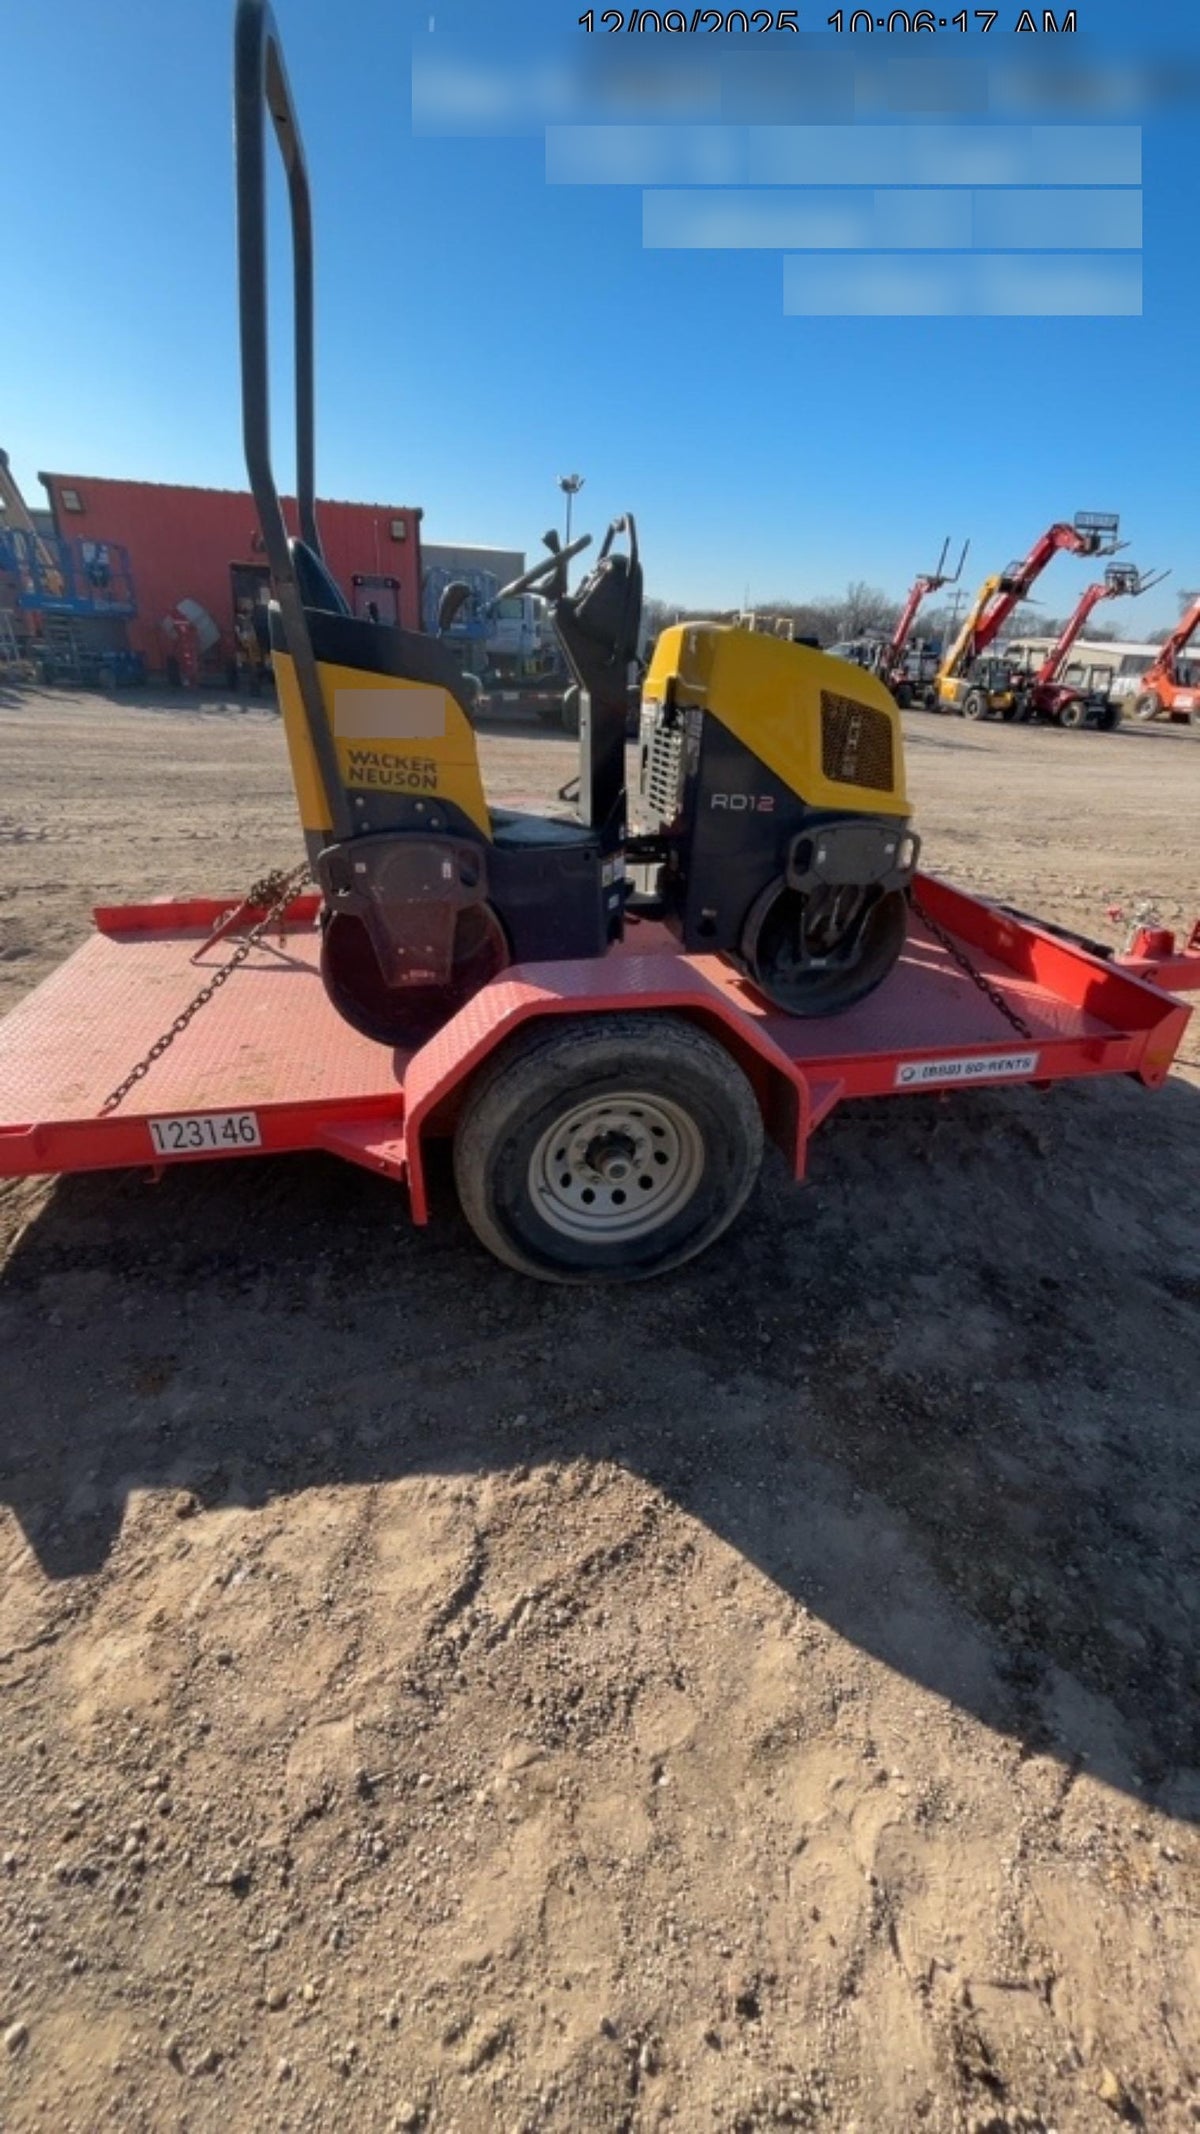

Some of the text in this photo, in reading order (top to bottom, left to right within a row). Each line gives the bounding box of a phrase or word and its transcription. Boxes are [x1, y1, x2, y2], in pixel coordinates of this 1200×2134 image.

[347, 748, 438, 774] WACKER
[348, 765, 438, 789] NEUSON
[710, 793, 775, 812] RD12
[151, 1116, 257, 1150] 123146
